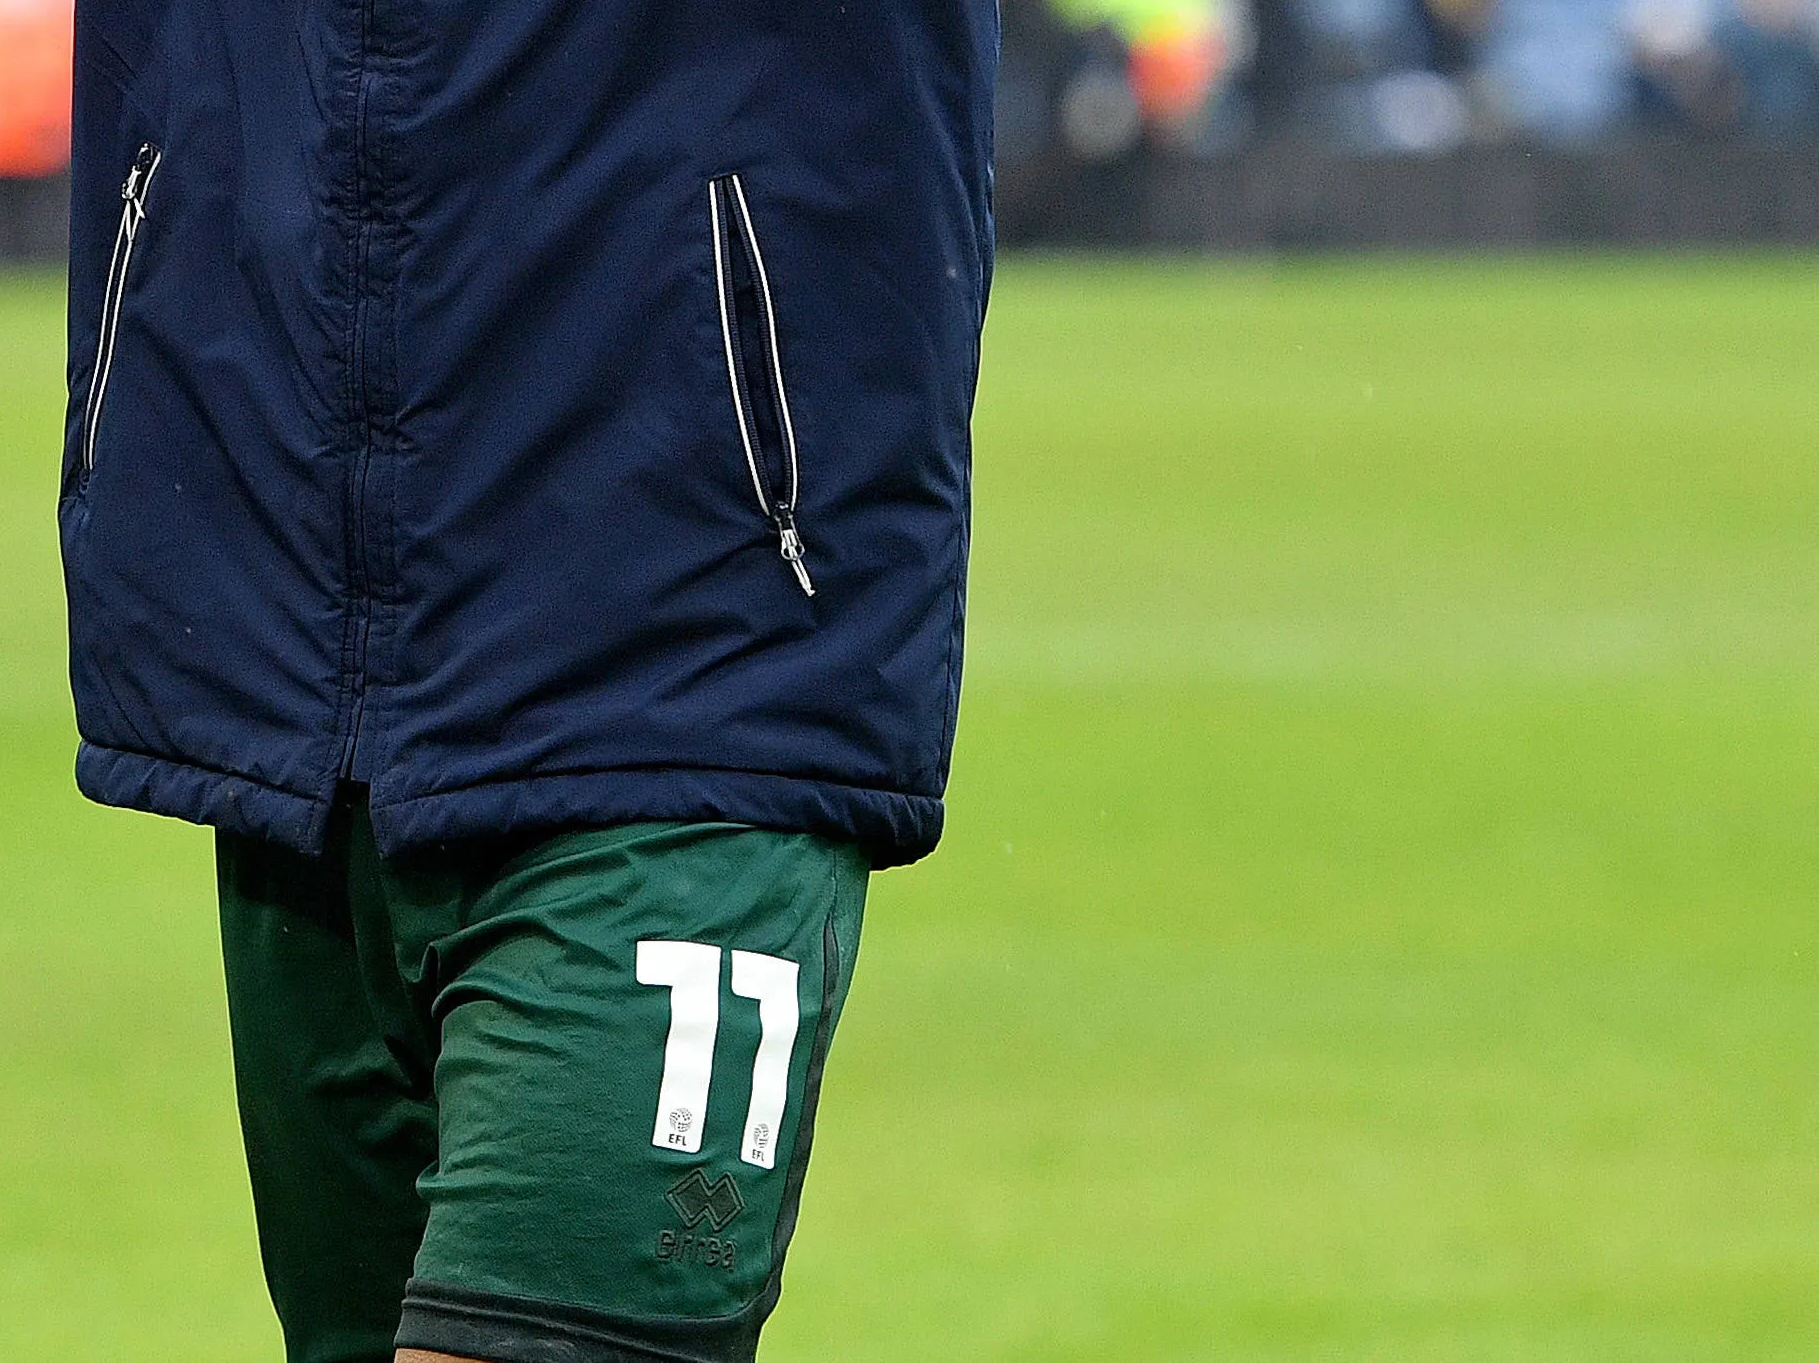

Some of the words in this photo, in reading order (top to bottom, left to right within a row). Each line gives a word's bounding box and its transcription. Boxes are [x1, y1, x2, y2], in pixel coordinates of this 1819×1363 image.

[636, 939, 800, 1170] 11
[668, 1133, 687, 1147] EFL
[752, 1149, 765, 1162] EFL
